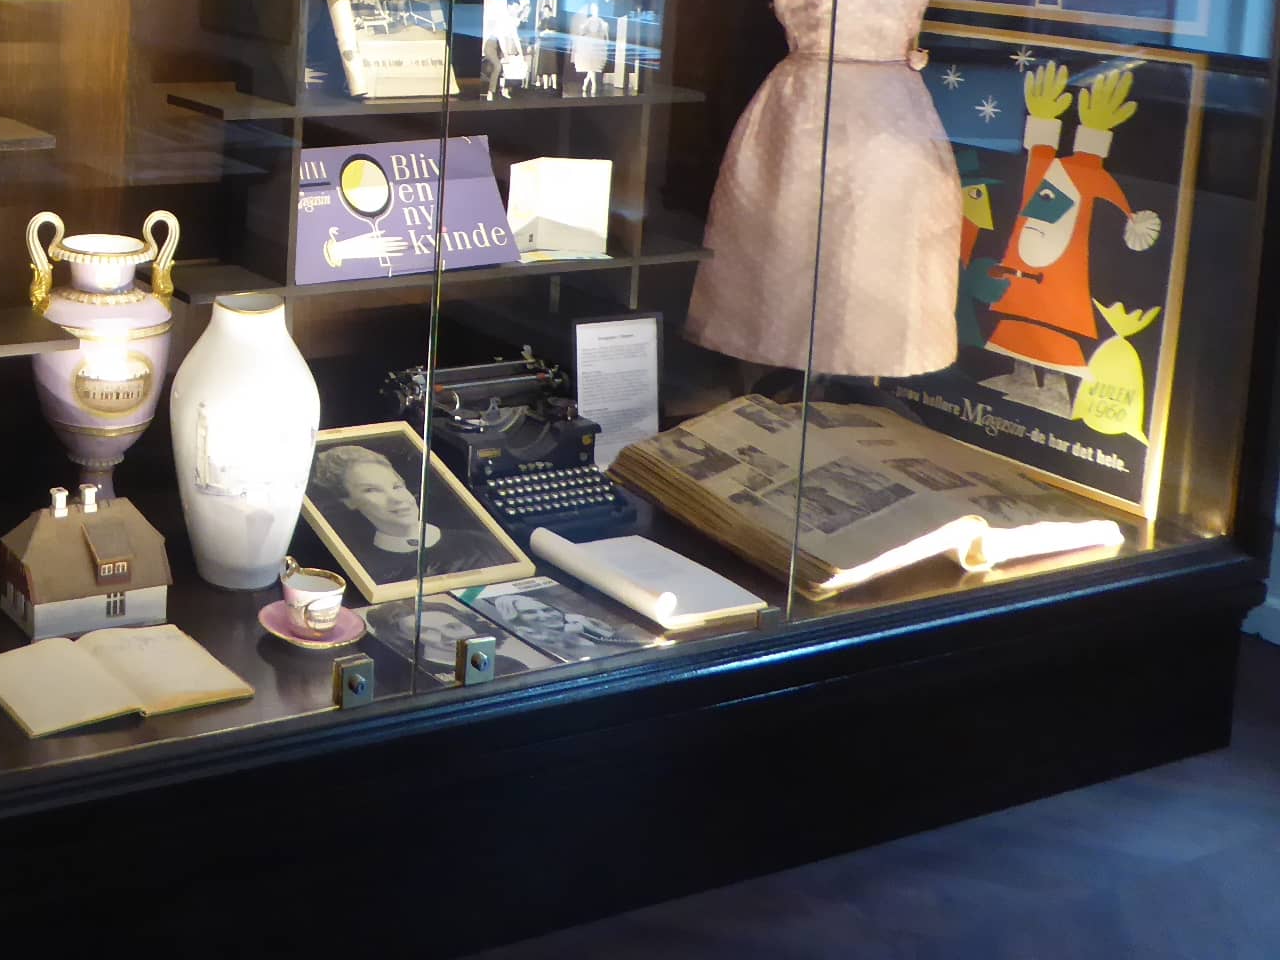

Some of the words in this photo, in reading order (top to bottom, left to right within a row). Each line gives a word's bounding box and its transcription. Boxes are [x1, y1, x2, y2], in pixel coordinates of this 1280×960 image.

[390, 153, 441, 181] Bliv
[398, 182, 435, 203] en
[403, 204, 436, 230] ny
[408, 223, 508, 255] kvinde
[1088, 382, 1137, 406] JULEN
[1071, 441, 1094, 463] det
